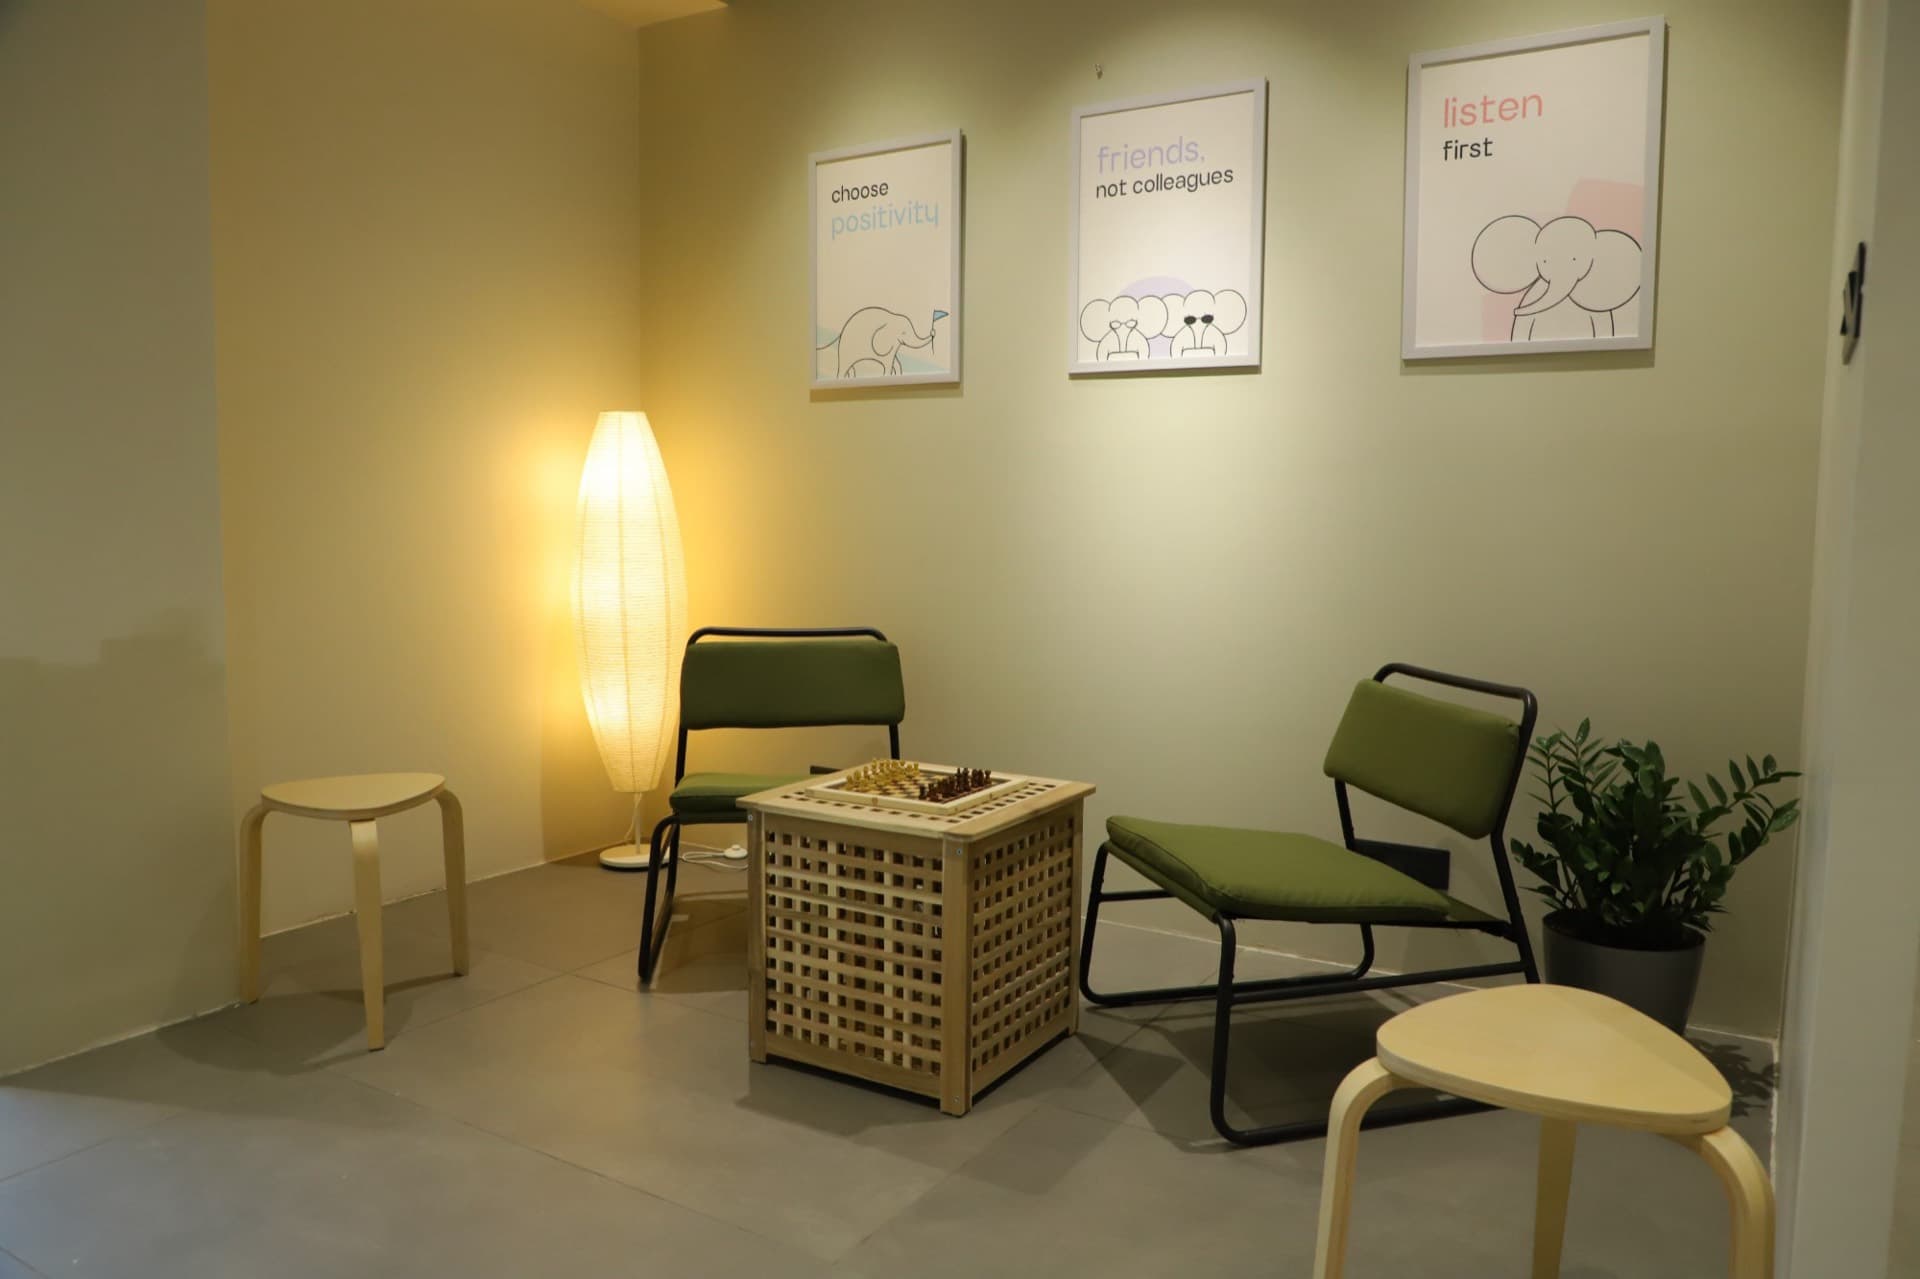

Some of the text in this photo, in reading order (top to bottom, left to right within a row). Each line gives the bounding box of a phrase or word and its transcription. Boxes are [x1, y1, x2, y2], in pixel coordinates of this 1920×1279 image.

[1443, 93, 1544, 128] listen
[1443, 137, 1494, 161] first
[831, 182, 889, 204] choose
[1096, 168, 1234, 199] not colleagues
[831, 200, 940, 240] positivity
